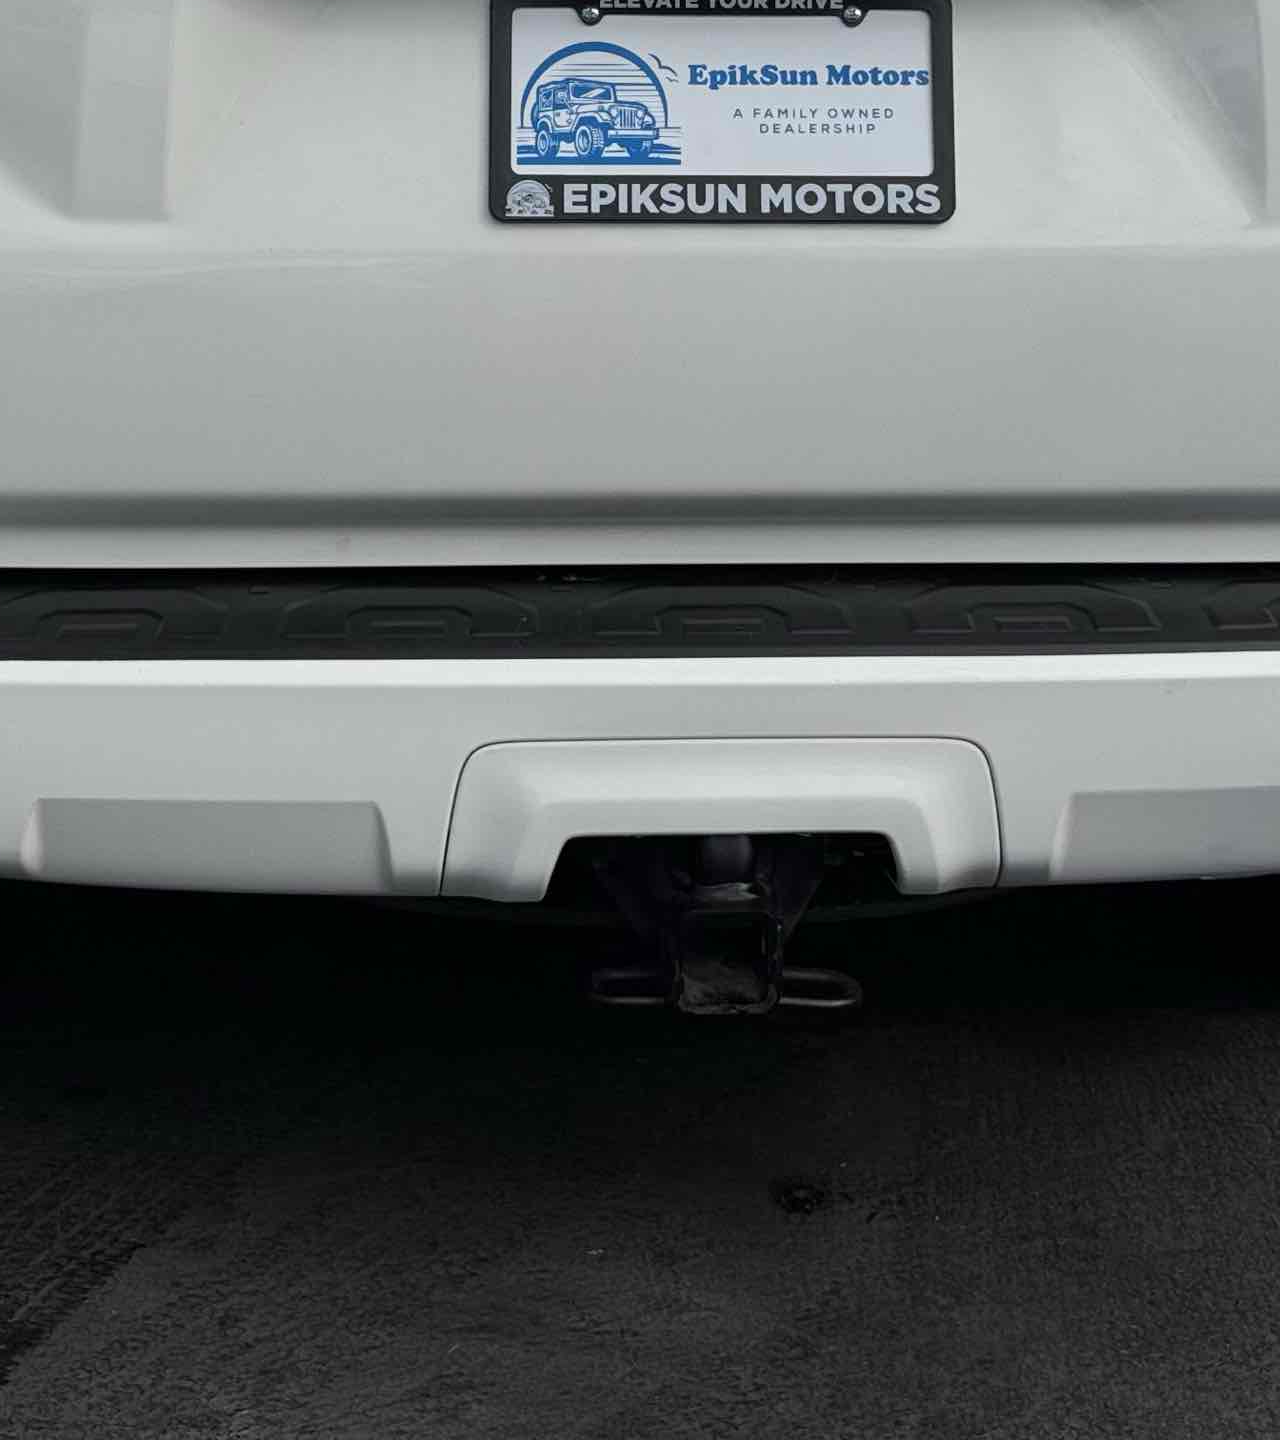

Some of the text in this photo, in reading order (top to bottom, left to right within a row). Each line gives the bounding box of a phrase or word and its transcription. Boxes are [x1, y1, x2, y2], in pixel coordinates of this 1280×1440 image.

[687, 63, 930, 91] EpikSun Motors
[732, 107, 895, 120] A FAMILY OWNED
[758, 122, 877, 135] DEALERSHIP
[562, 182, 942, 215] EPIKSUN MOTORS
